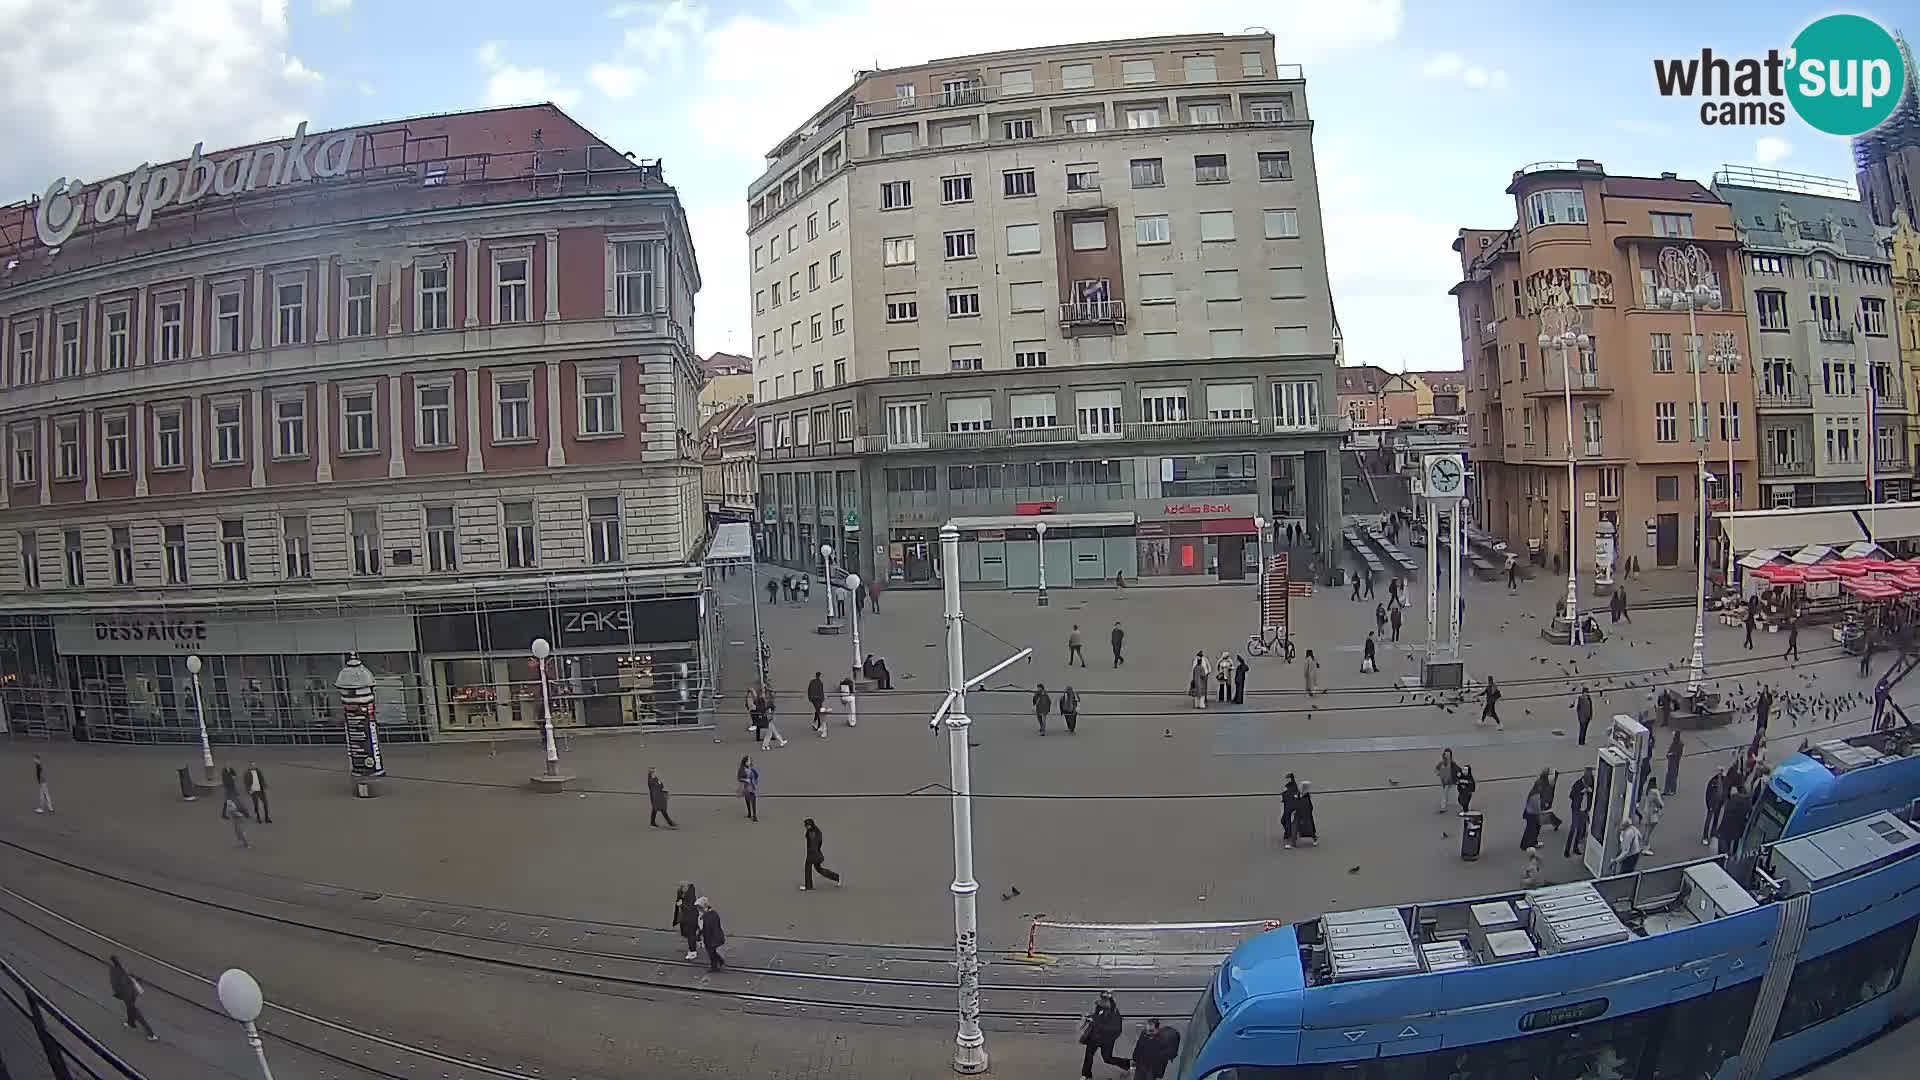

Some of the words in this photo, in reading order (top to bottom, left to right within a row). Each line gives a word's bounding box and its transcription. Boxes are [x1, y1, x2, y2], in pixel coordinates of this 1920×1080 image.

[1203, 503, 1233, 513] Bank
[95, 620, 208, 641] DESSANGE
[562, 610, 633, 632] ZAKS
